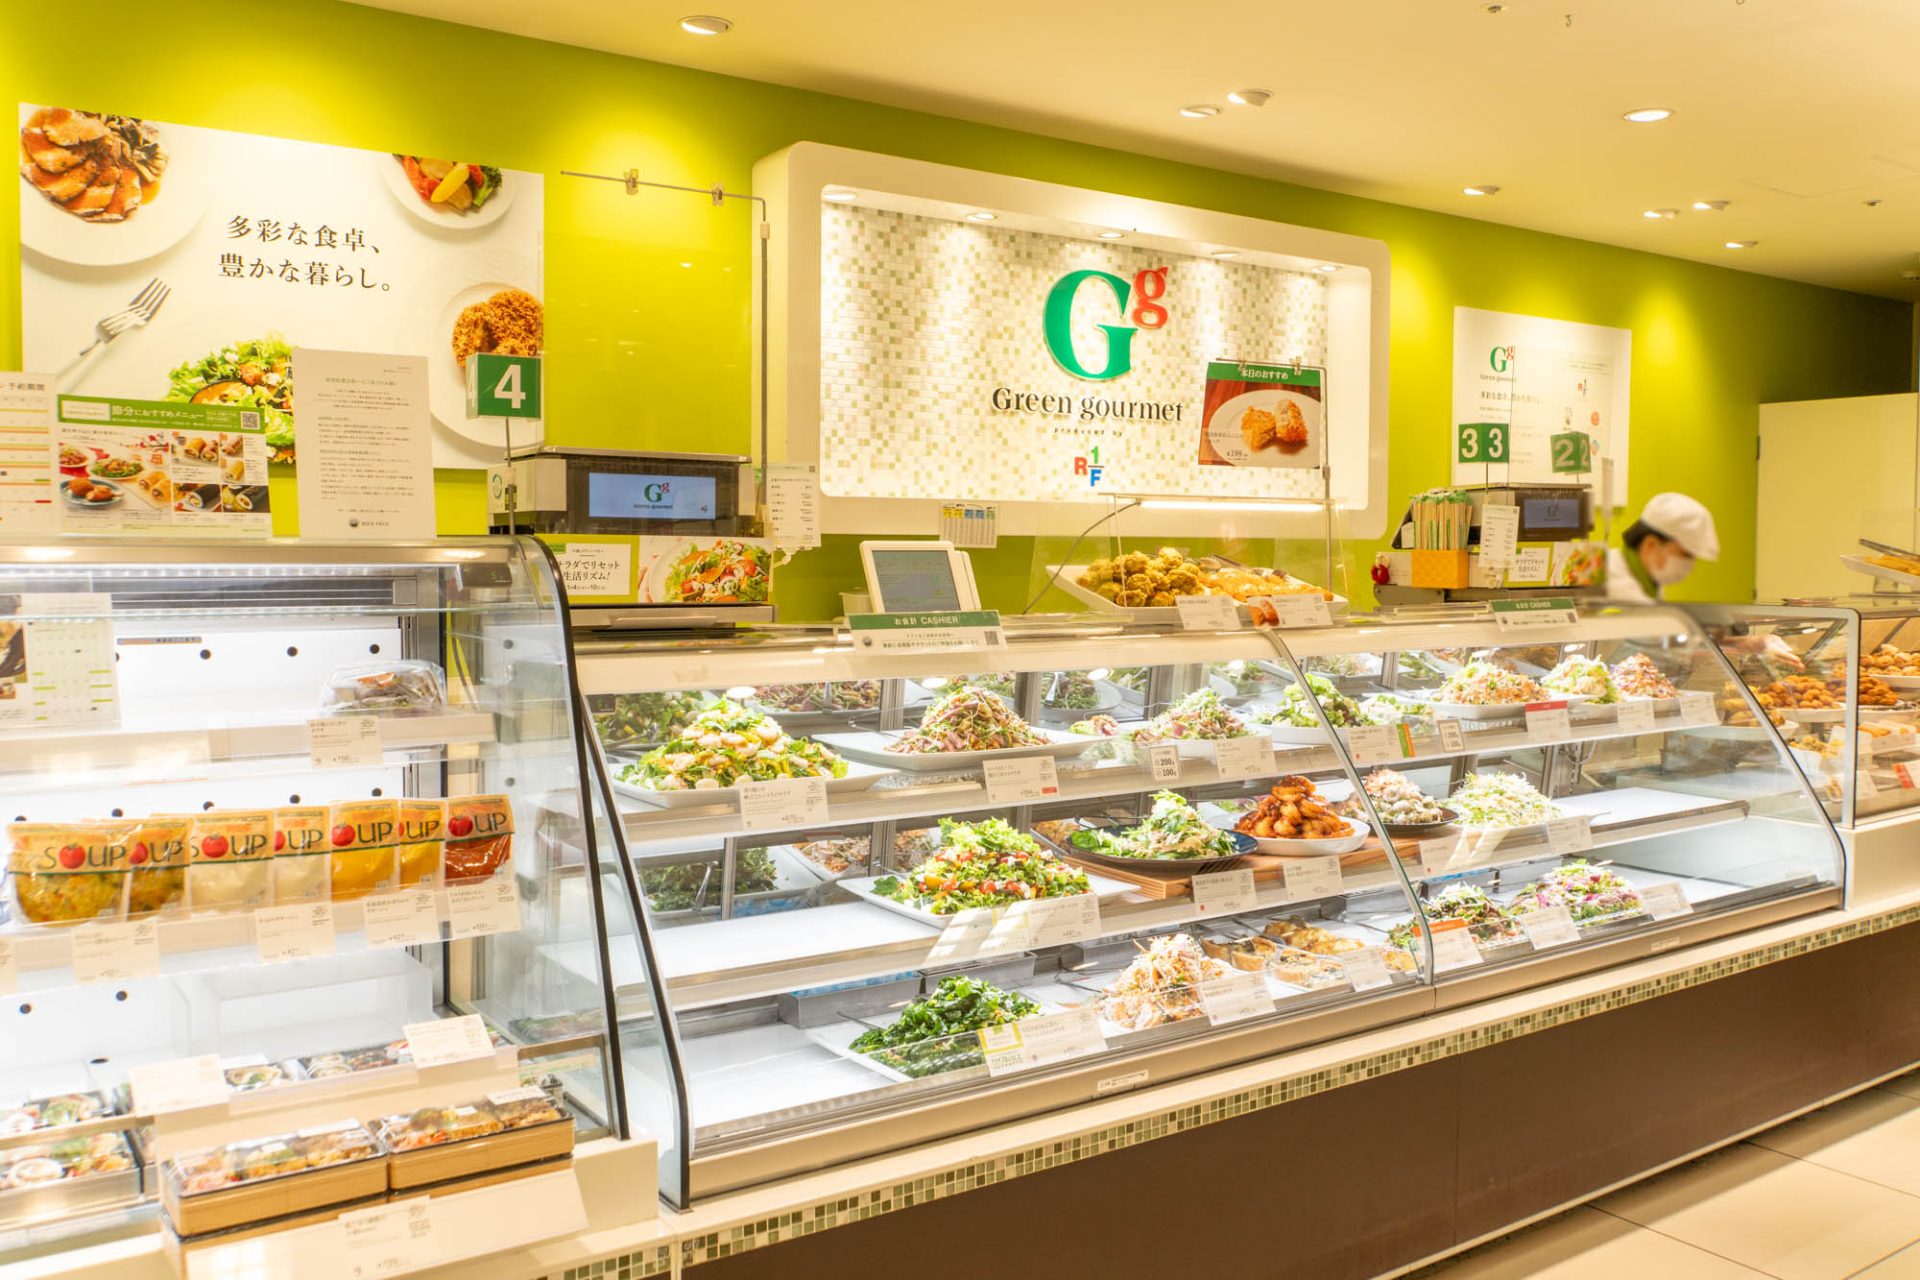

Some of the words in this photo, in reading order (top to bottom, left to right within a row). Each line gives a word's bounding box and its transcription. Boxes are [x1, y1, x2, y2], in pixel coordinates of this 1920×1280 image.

[227, 215, 380, 254] 多彩な食卓、
[218, 252, 390, 292] 豊かな暮らし。
[494, 364, 526, 409] 4
[992, 387, 1072, 414] Green
[1080, 395, 1184, 422] gourmet
[1054, 427, 1105, 436] produced
[1461, 428, 1479, 459] 3
[1488, 427, 1503, 459] 3
[1554, 438, 1575, 467] 2
[920, 615, 959, 625] CASHIER
